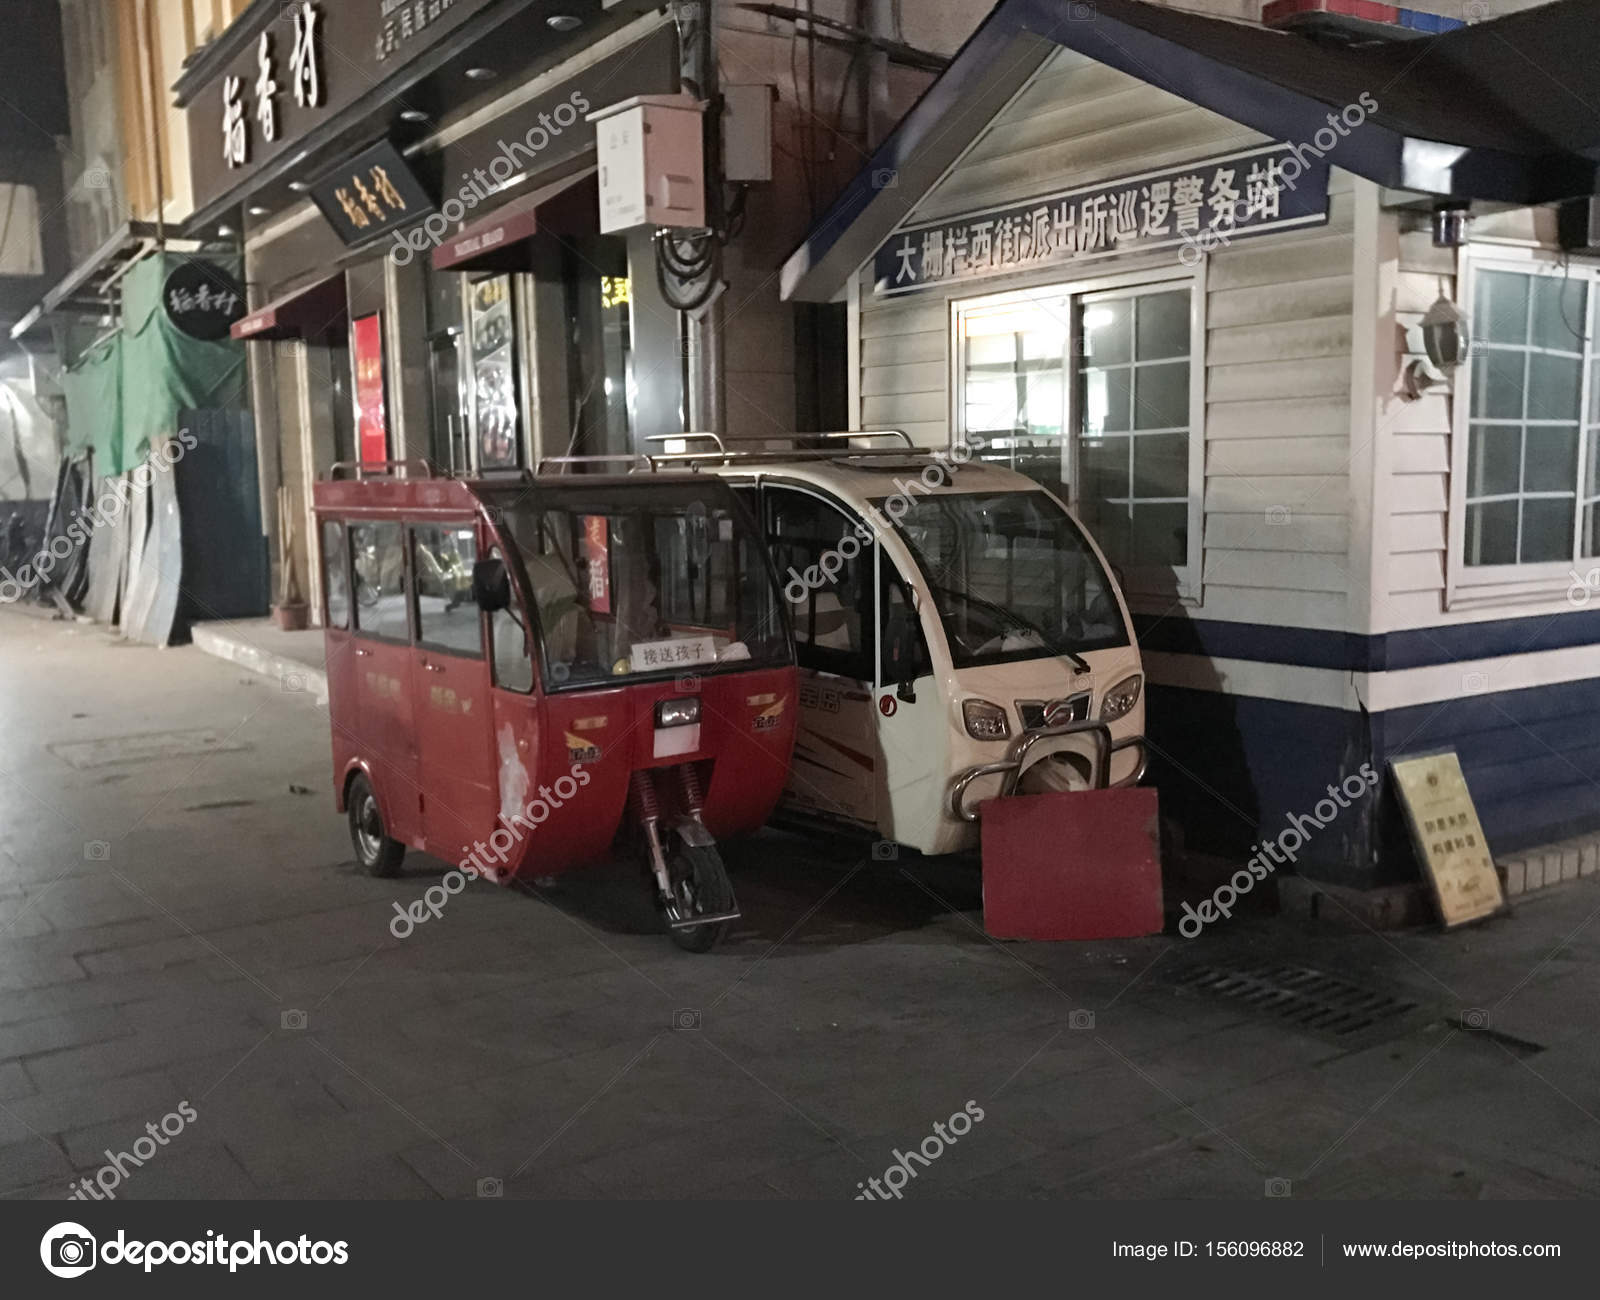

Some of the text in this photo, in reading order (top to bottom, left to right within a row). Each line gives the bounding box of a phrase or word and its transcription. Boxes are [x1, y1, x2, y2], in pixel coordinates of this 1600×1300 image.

[222, 2, 318, 169] 稻香村
[335, 165, 406, 229] 稻香村
[896, 157, 1280, 283] 大栅栏西街派出所巡逻警务站
[644, 642, 704, 665] 接送孩子
